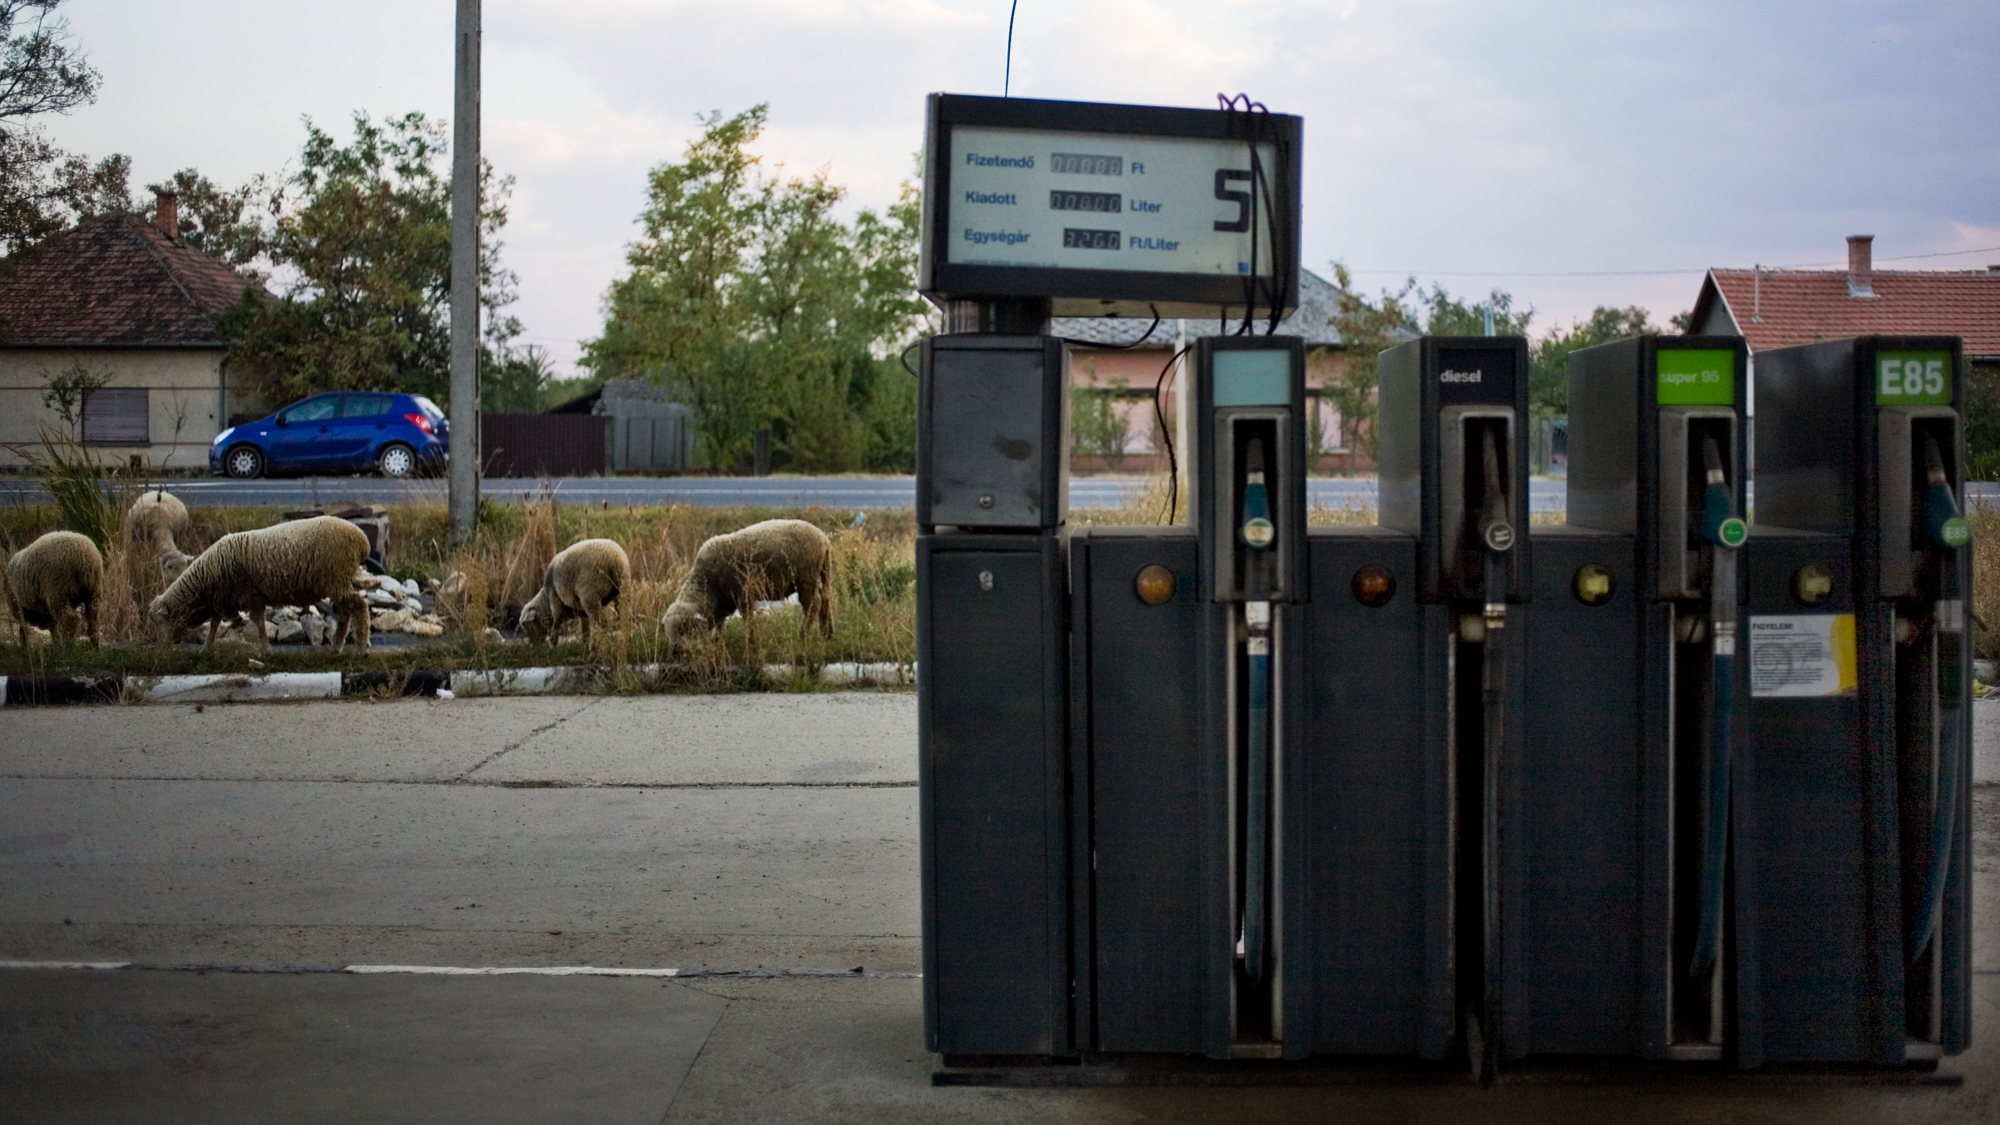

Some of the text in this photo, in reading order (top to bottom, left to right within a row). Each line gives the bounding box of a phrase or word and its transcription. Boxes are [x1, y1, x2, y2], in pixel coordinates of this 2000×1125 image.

[966, 153, 1035, 169] Fizetendő
[1131, 162, 1145, 175] Ft
[965, 191, 1017, 206] Kiadott
[1213, 168, 1252, 233] 5
[1130, 199, 1162, 214] Liter
[964, 229, 1030, 245] Egységár
[1129, 235, 1180, 251] Ft/Liter
[1440, 369, 1482, 384] diesel
[1660, 370, 1720, 385] super 95
[1881, 359, 1944, 396] E85
[1946, 526, 1968, 539] E85
